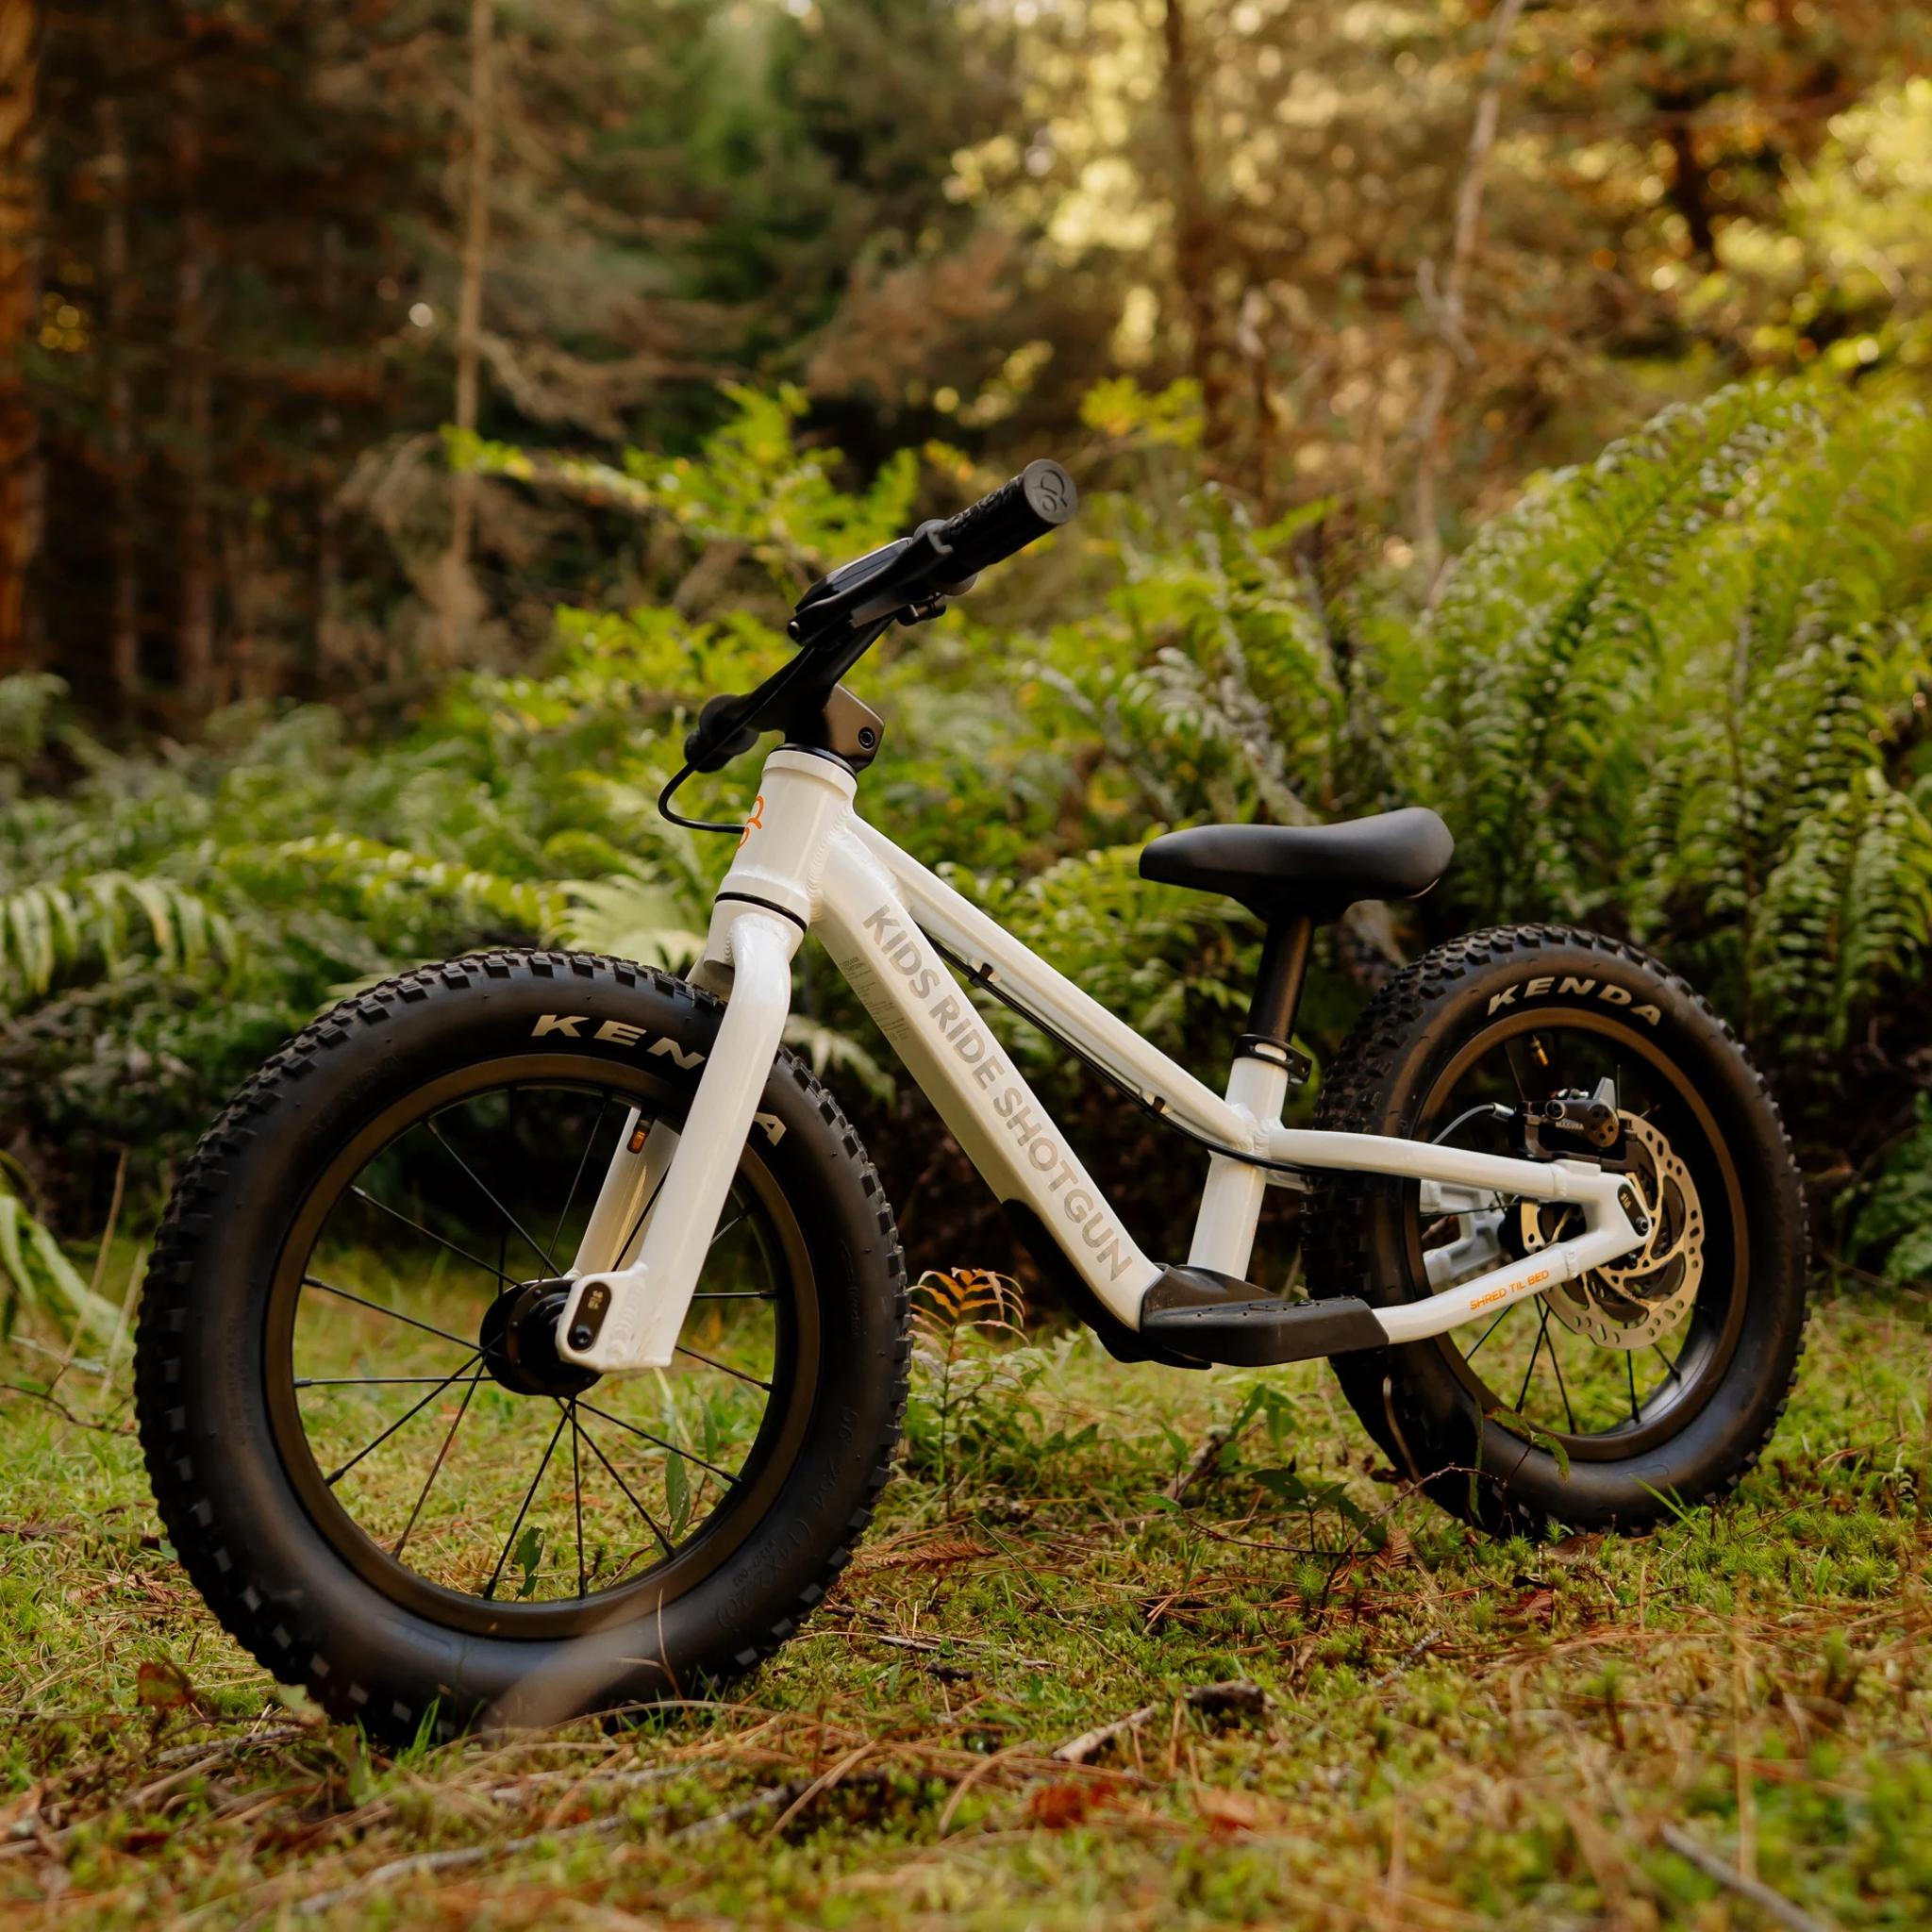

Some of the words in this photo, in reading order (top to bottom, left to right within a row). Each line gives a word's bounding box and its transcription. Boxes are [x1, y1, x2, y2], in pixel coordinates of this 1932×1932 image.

[1488, 976, 1661, 1026] KENDA
[531, 1014, 787, 1146] KENA
[861, 906, 941, 999] KIDS
[928, 993, 1006, 1091] RIDE
[992, 1087, 1132, 1282] SHOTGUN
[1470, 1288, 1507, 1310] SHRED
[1509, 1282, 1525, 1293] TIL
[1528, 1270, 1550, 1286] BED
